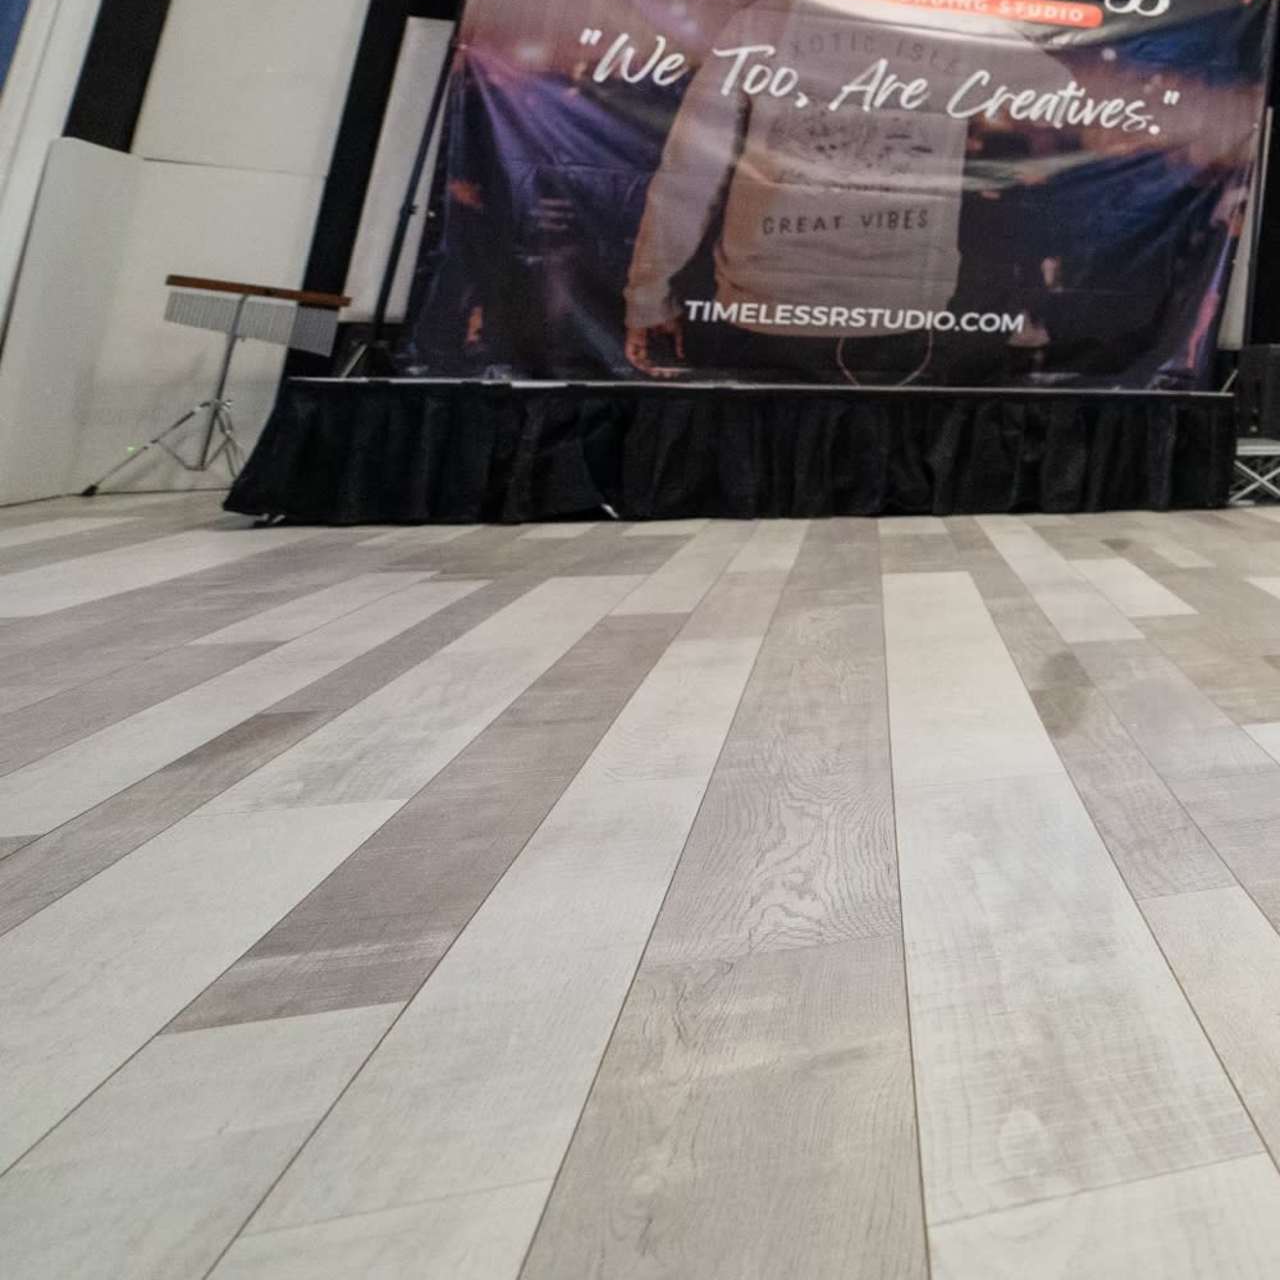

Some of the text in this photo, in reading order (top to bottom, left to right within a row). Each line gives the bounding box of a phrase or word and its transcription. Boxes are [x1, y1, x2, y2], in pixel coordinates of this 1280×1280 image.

[999, 0, 1085, 23] STUDIO
[579, 28, 1180, 135] "We Too, Are Creatives."
[761, 209, 929, 235] GREAT VIBES
[685, 299, 1025, 334] TIMELESSRSTUDIO.COM
